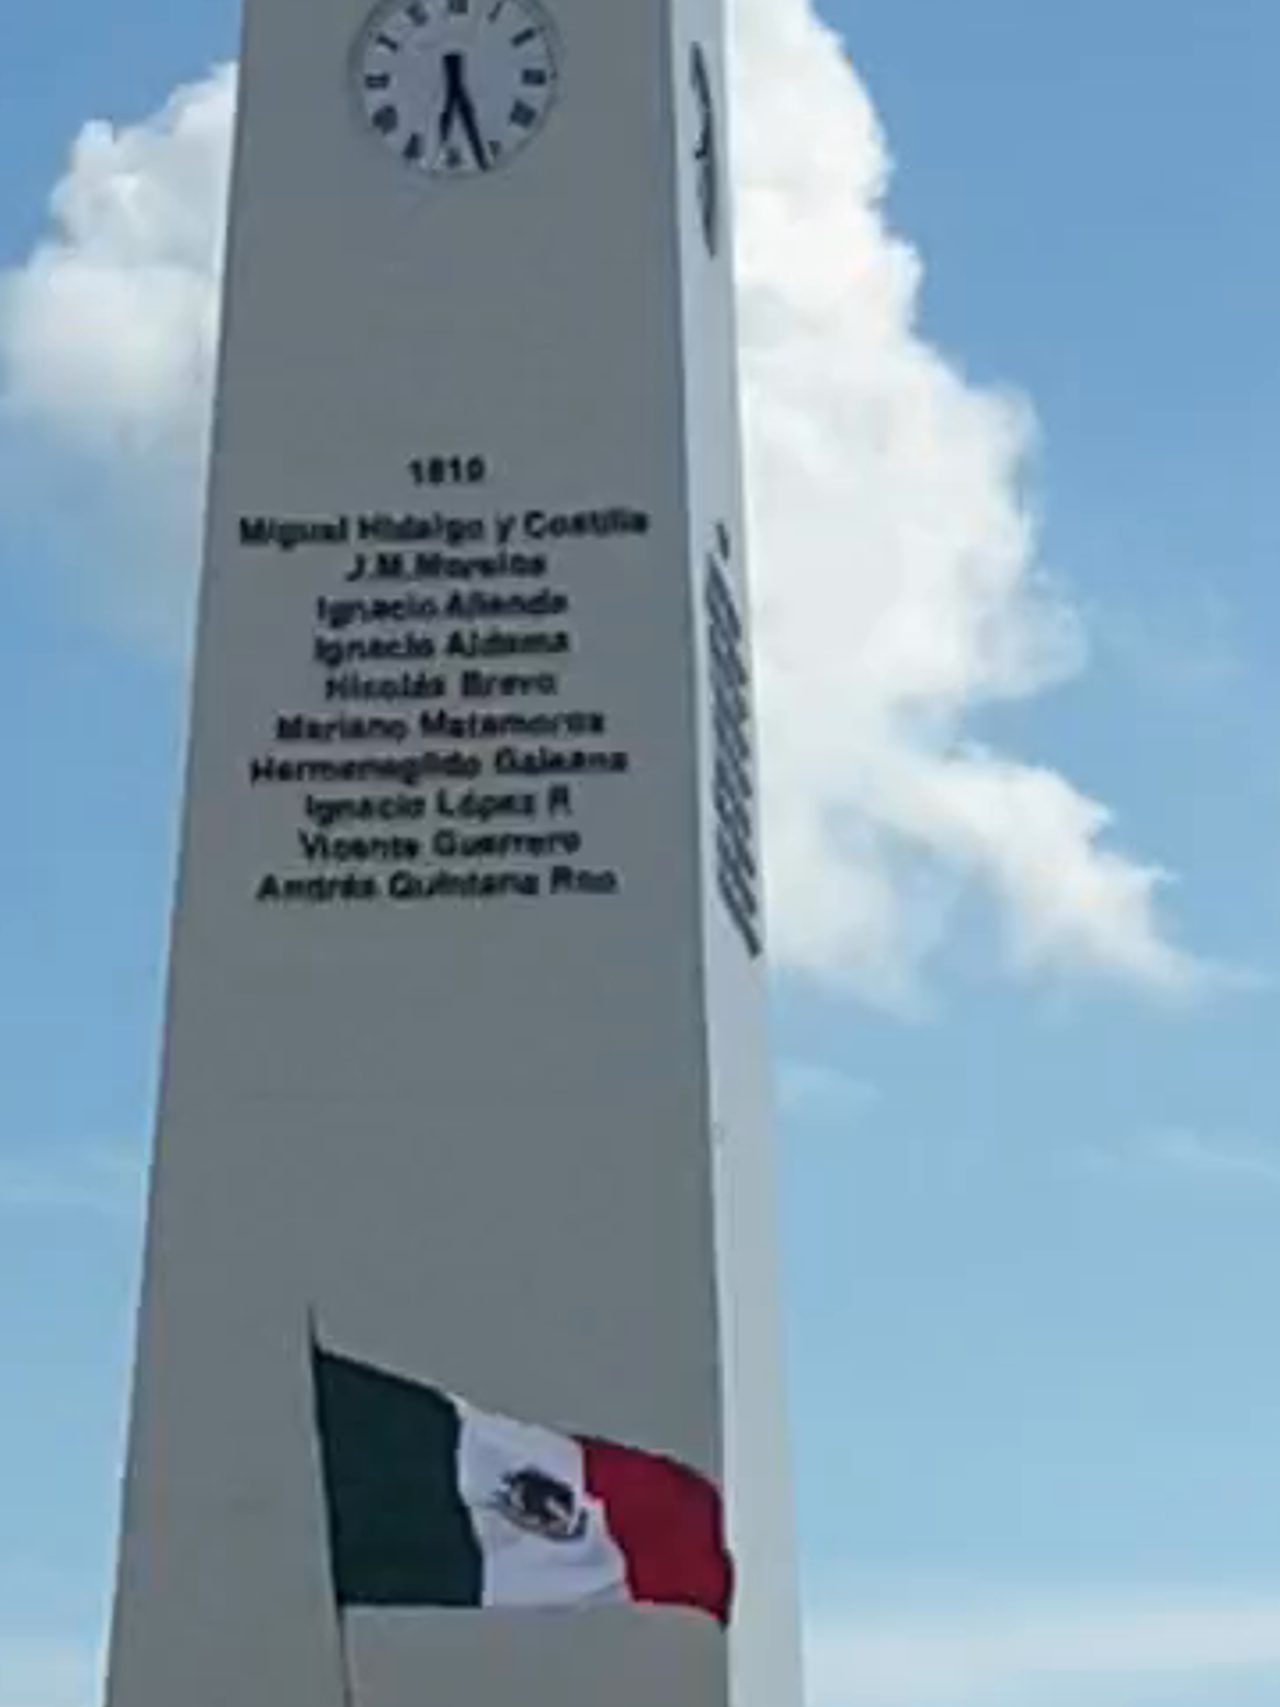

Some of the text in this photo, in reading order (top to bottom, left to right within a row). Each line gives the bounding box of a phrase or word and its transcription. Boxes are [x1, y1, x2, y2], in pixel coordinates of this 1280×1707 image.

[409, 455, 486, 486] 1810
[239, 508, 649, 552] Miguel Hidalgo y Costilla
[317, 589, 568, 630] Ignacio Allende
[313, 631, 569, 667] Ignacio Aldama
[462, 672, 557, 696] Bravo
[276, 711, 605, 742] Mariano Matamoros
[495, 748, 628, 775] Galeana
[305, 795, 425, 827] Ignacio
[299, 828, 581, 862] Vicente Guerrero
[388, 871, 539, 900] Quintana
[550, 865, 617, 894] Roo
